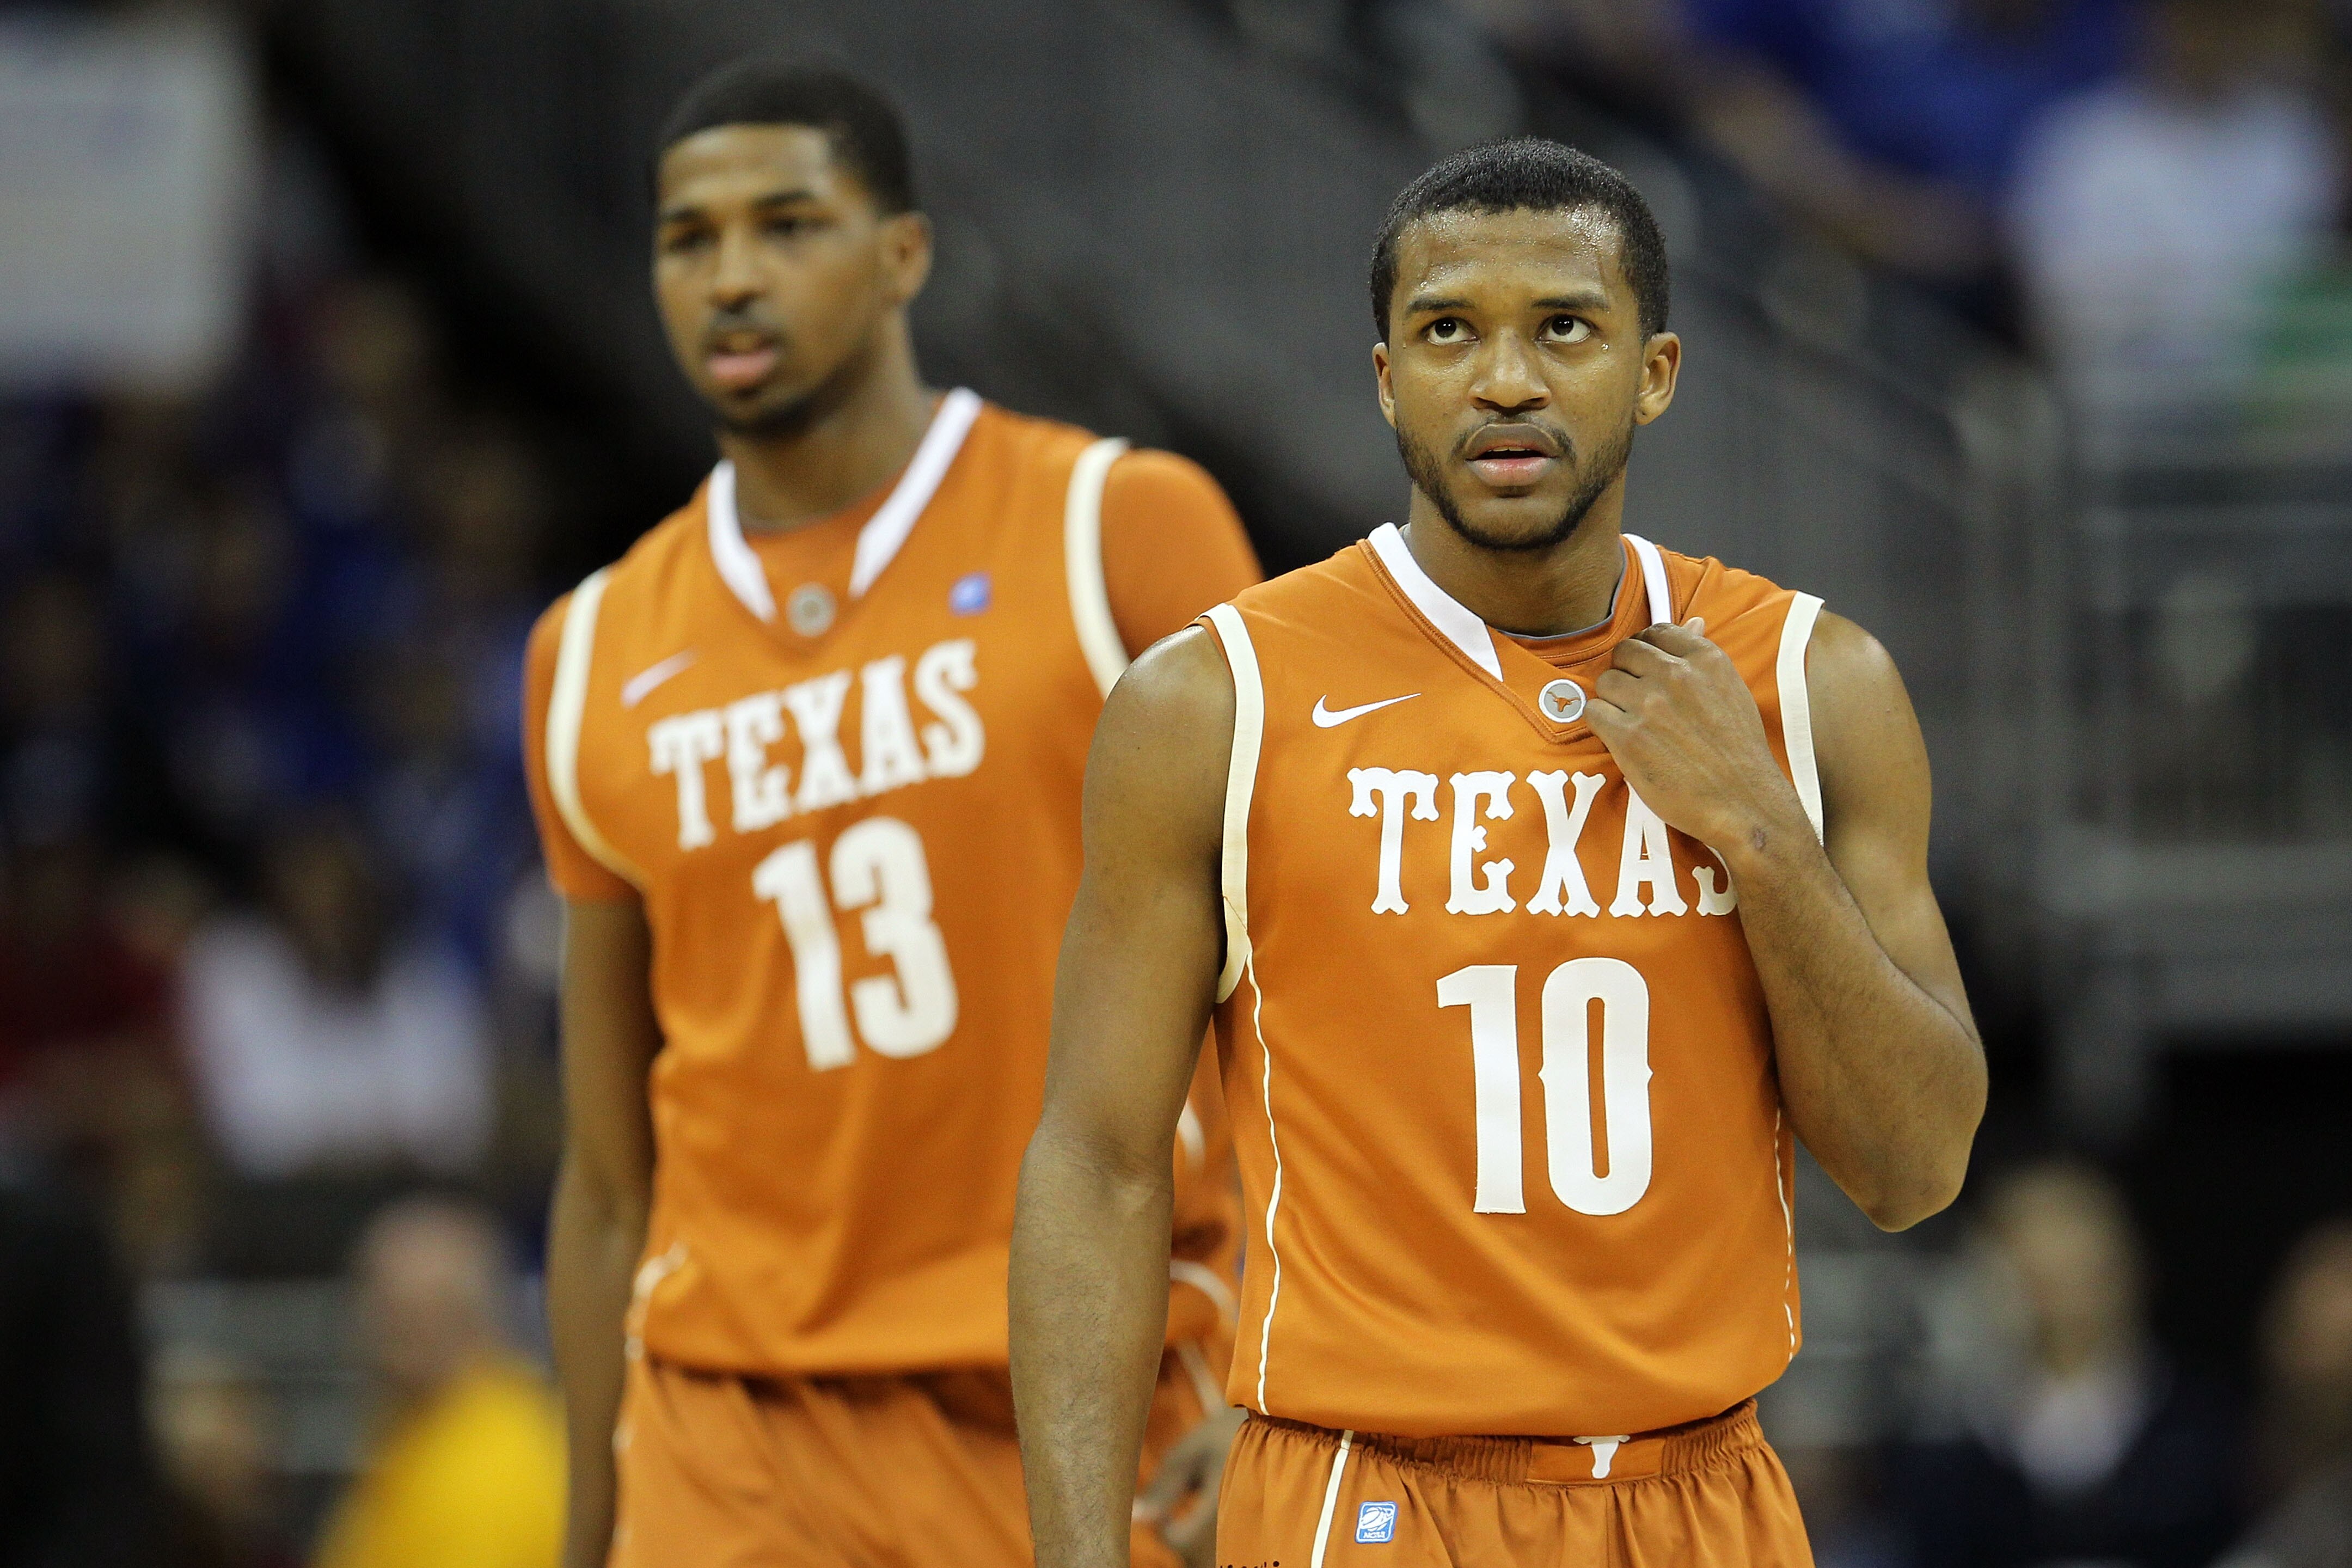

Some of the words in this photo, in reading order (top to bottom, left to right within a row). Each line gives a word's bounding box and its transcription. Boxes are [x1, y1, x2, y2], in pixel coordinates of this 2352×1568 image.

[648, 638, 985, 850] TEXAS
[752, 817, 958, 1071] 13
[1436, 957, 1653, 1215] 10
